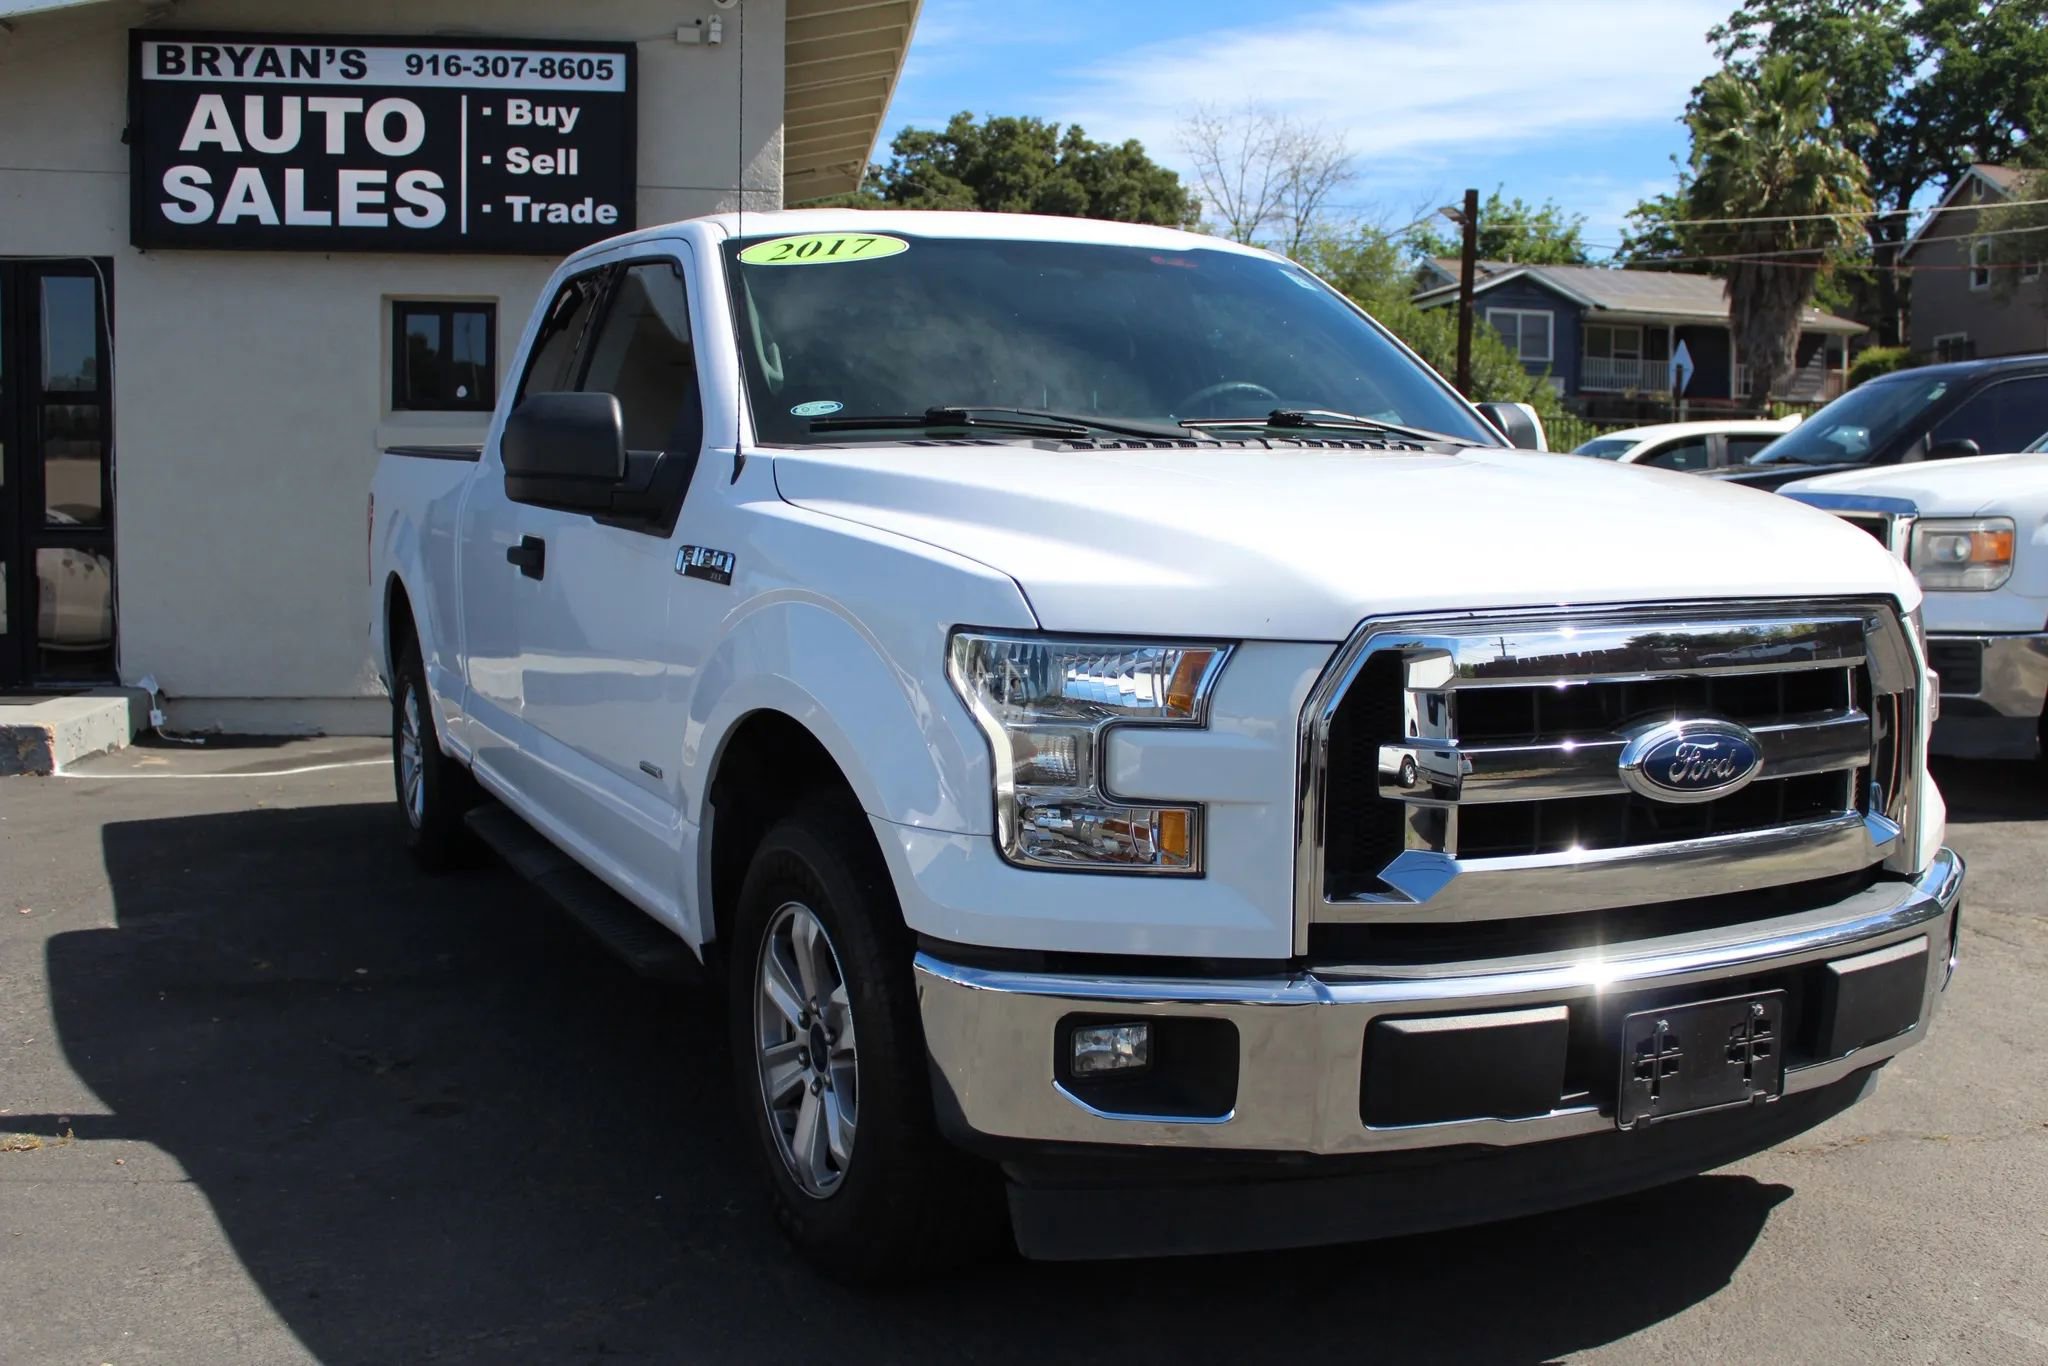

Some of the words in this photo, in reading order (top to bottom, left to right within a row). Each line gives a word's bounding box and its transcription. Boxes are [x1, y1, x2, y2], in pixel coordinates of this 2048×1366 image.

[156, 45, 368, 79] BRYAN'S
[405, 54, 614, 80] 916-307-8605
[179, 94, 426, 155] AUTO
[506, 99, 580, 133] Buy
[505, 147, 579, 176] Sell
[160, 165, 447, 229] SALES
[505, 195, 618, 225] Trade
[768, 238, 877, 261] 2017
[1668, 741, 1737, 783] Ford
